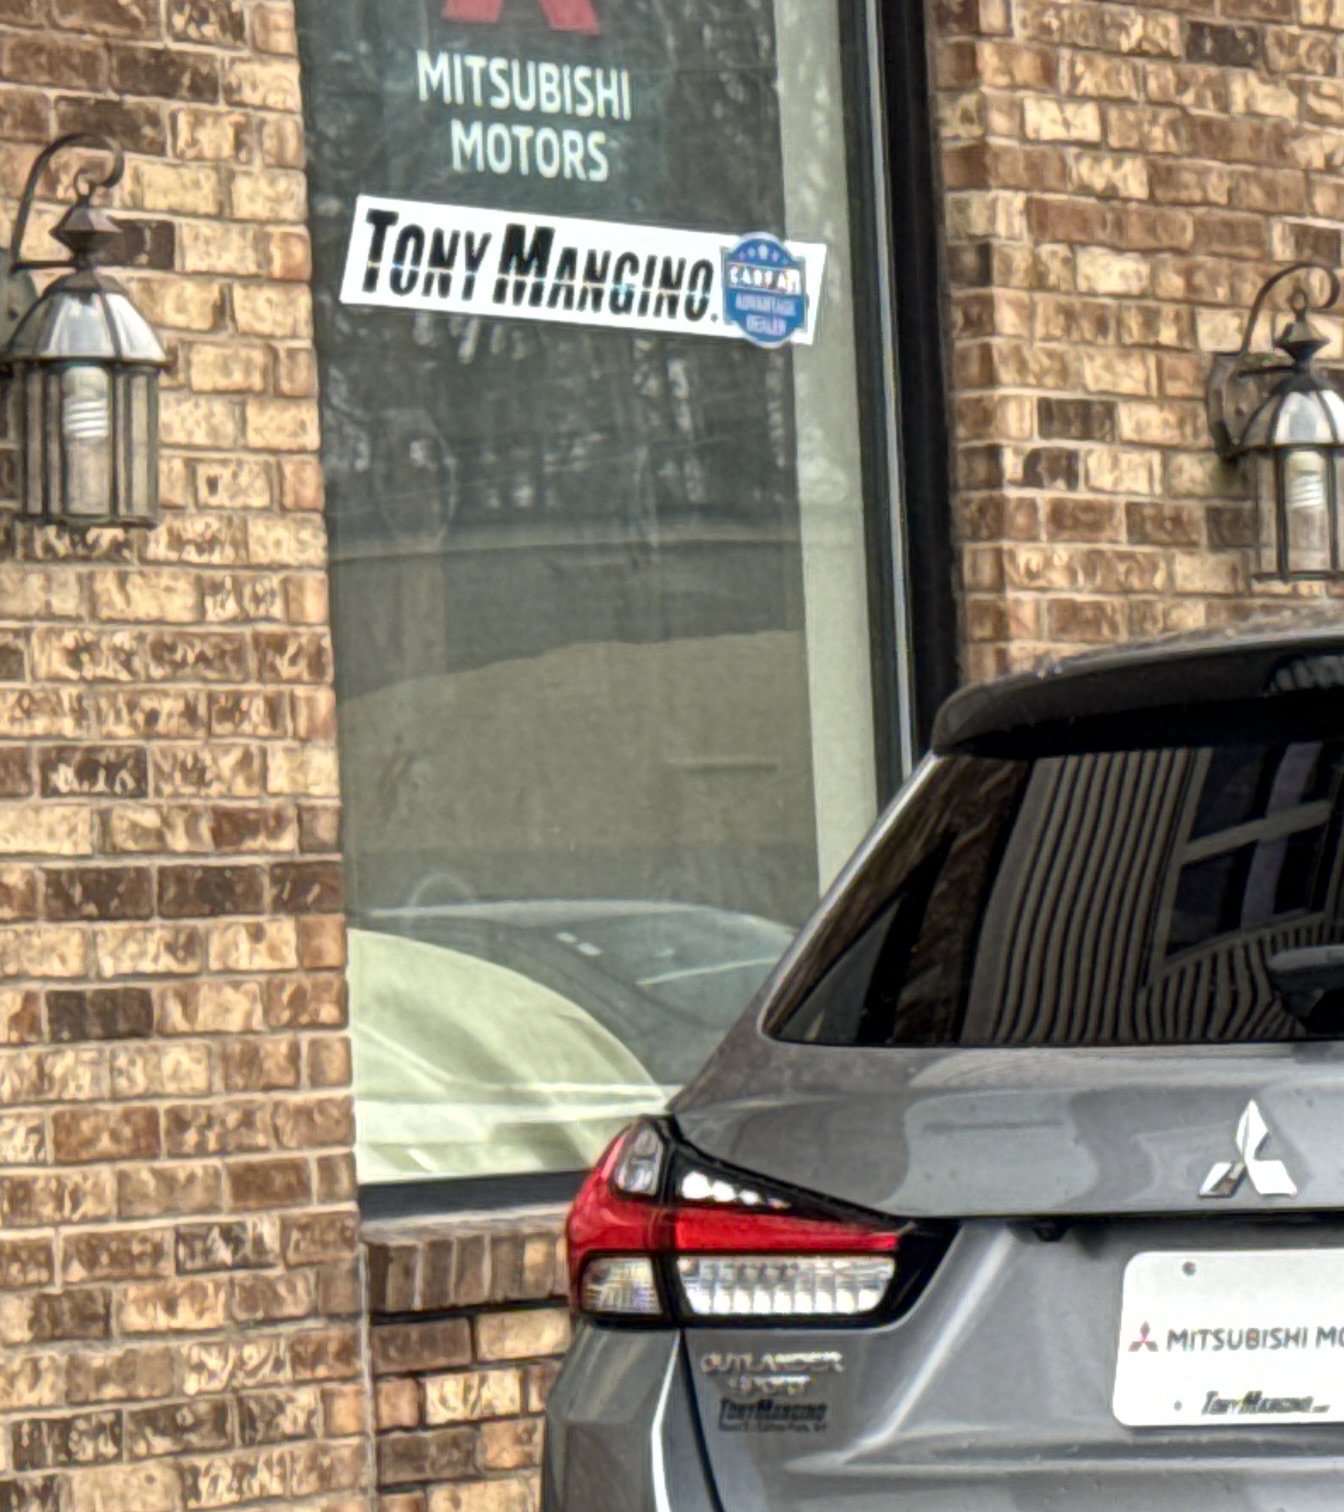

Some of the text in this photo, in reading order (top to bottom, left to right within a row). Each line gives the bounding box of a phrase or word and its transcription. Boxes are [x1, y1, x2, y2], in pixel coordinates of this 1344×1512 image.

[415, 49, 632, 122] MITSUBISHI
[450, 117, 610, 183] MOTORS
[361, 207, 493, 302] TONY
[1166, 1326, 1308, 1352] MITSUBISHI
